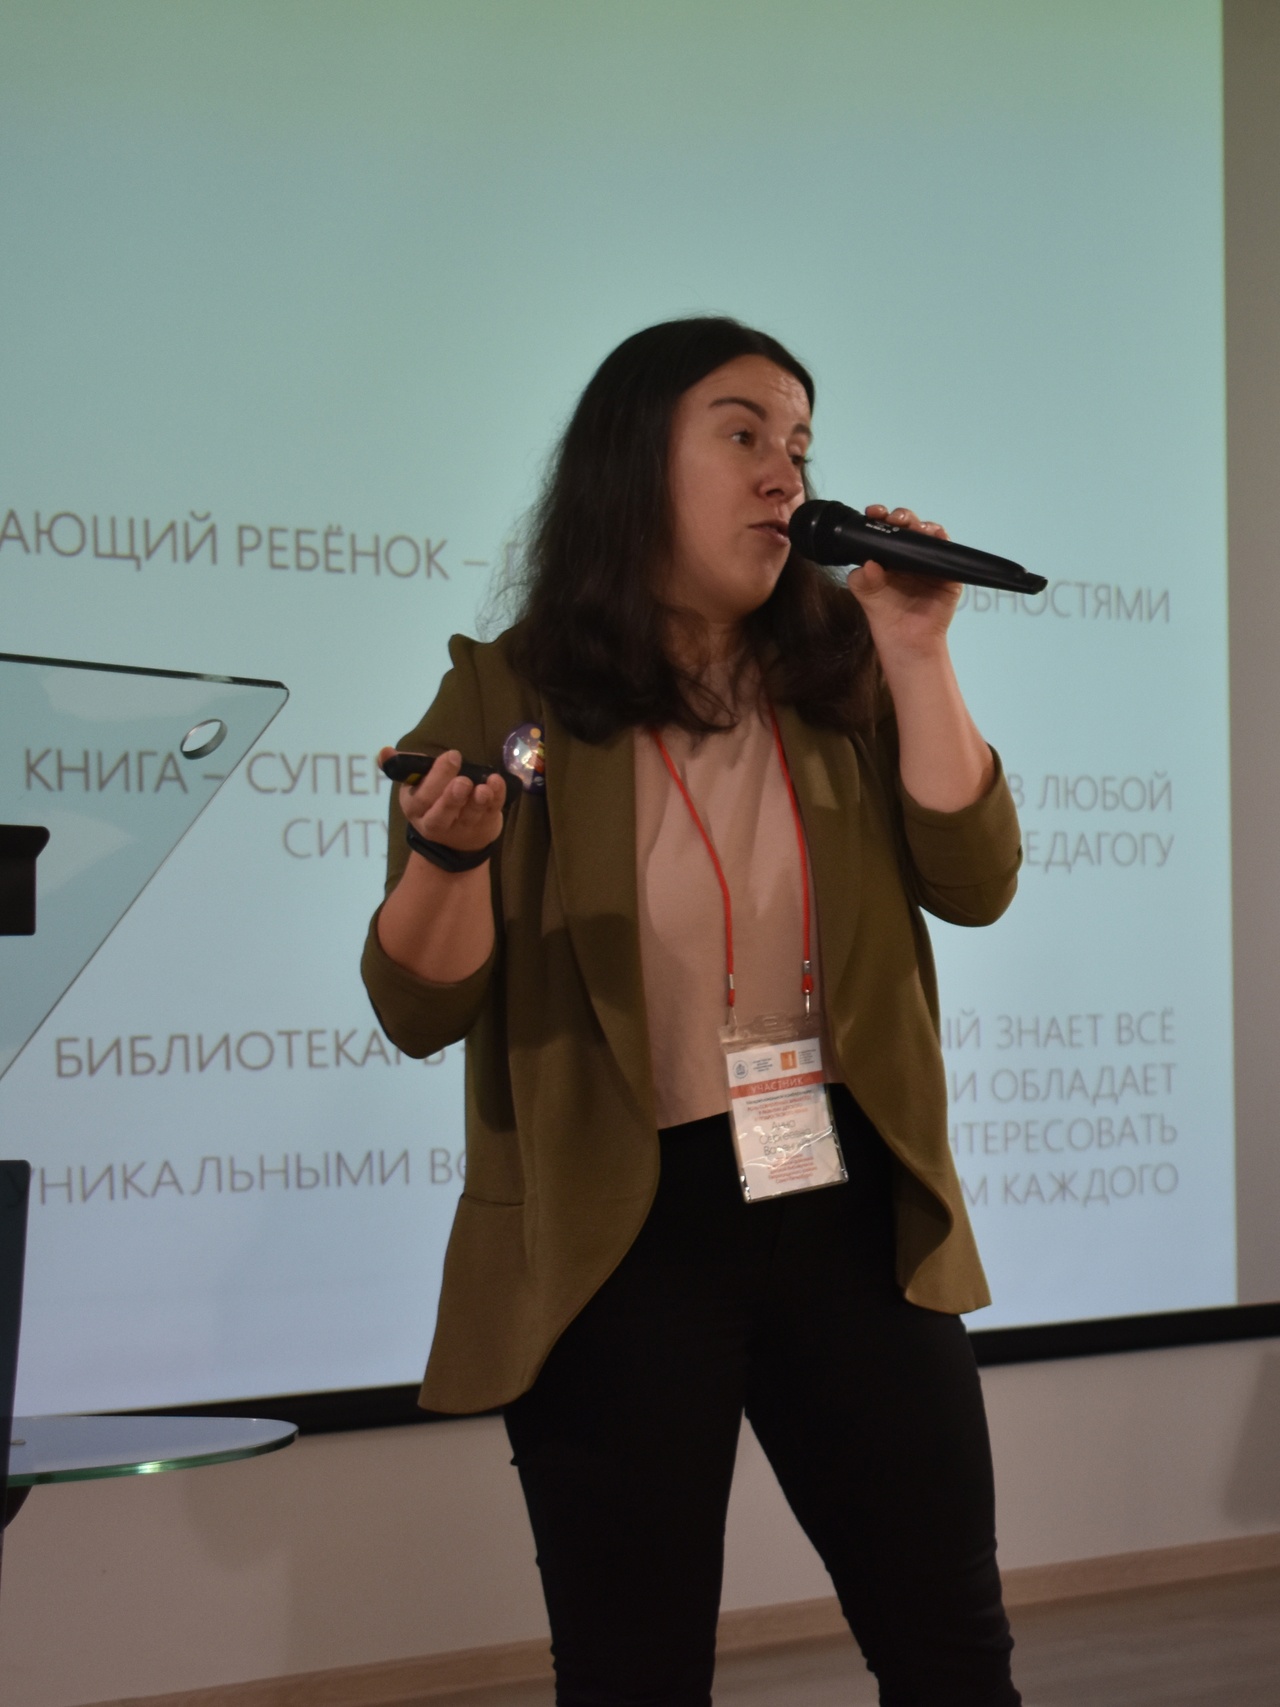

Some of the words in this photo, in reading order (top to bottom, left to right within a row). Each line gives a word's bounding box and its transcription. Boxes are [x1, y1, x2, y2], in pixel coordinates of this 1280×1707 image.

[0, 509, 218, 571] АЮЩИЙ
[238, 525, 450, 580] РЕБЁНОК
[25, 748, 189, 793] КНИГА
[1038, 769, 1173, 812] ЛЮБОЙ
[1024, 830, 1176, 874] ЕДАГОГУ
[996, 1013, 1103, 1050] ЗНАЕТ
[1116, 1006, 1177, 1047] ВСЁ
[751, 1077, 804, 1093] УЧАСТНИК
[990, 1062, 1178, 1107] ОБЛАДАЕТ
[31, 1148, 410, 1206] НИКАЛЬНЫМИ
[1003, 1162, 1180, 1207] КАЖДОГО
